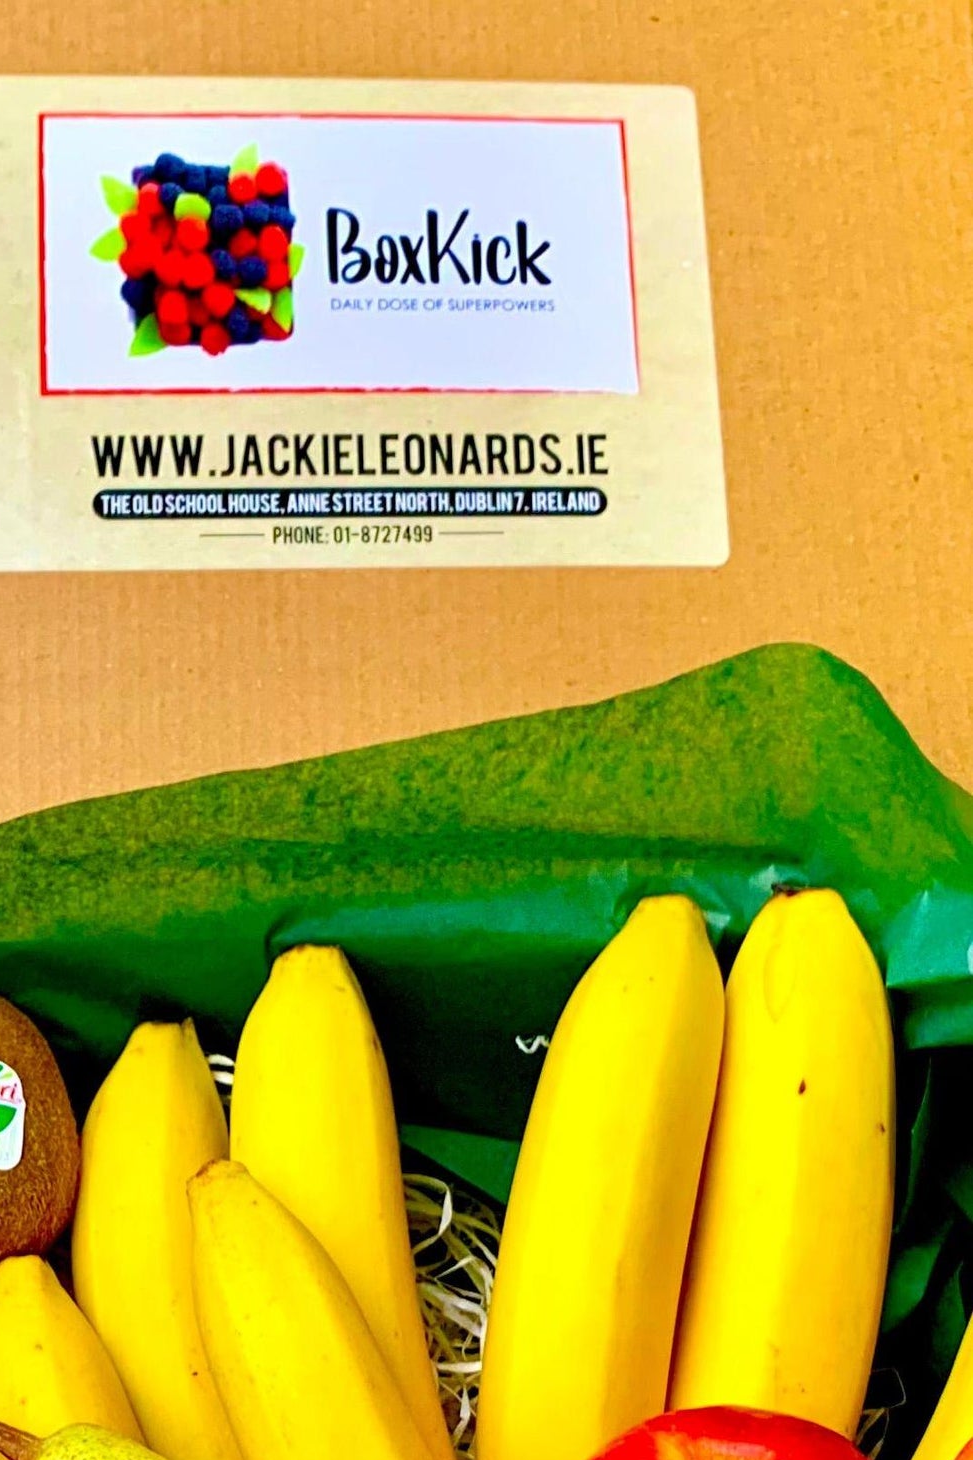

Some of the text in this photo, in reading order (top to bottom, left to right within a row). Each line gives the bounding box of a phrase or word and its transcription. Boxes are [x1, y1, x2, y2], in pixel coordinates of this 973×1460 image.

[327, 207, 552, 285] BoxKick
[330, 298, 555, 312] DAILY DOSE OF SUPERPOWERS
[91, 433, 609, 478] WWW.JACKIELEONARDS.IE
[100, 494, 130, 515] THE
[132, 494, 164, 515] OLD
[165, 493, 227, 515] SCHOOL
[228, 493, 286, 516] HOUSE,
[287, 492, 331, 514] ANNE
[332, 492, 393, 514] STREET
[395, 492, 455, 515] NORTH,
[455, 491, 512, 513] DUBLIN
[532, 491, 601, 513] IRELAND
[272, 525, 433, 545] PHONE: 01-8727499
